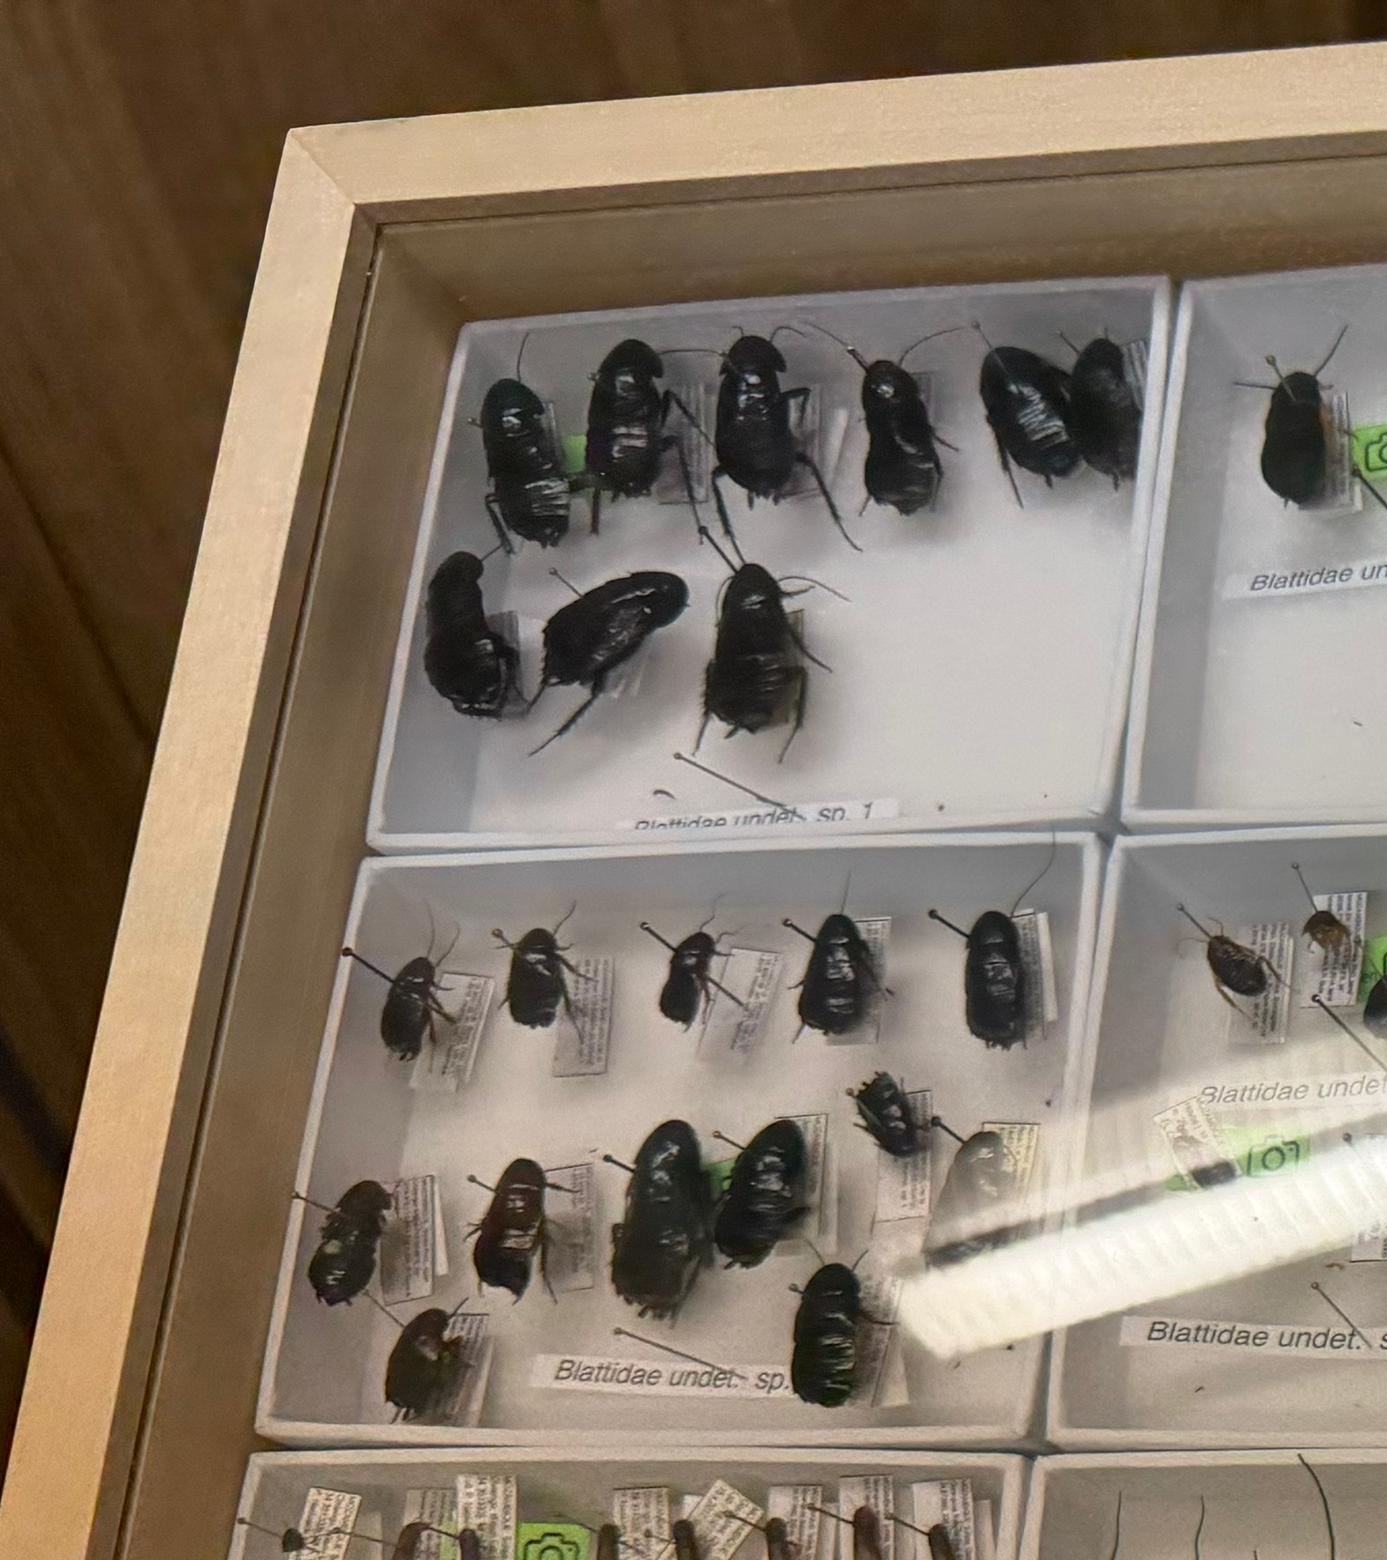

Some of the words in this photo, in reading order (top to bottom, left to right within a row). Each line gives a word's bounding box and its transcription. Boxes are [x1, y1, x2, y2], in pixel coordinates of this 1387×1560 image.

[1250, 567, 1353, 592] Blattidae
[863, 802, 875, 820] 1
[1200, 1082, 1309, 1105] Blattidae
[1147, 1321, 1268, 1347] Blattidae
[1278, 1327, 1362, 1351] undet.
[554, 1359, 662, 1386] Blattidae
[669, 1367, 739, 1390] undet.
[755, 1371, 790, 1393] sp.
